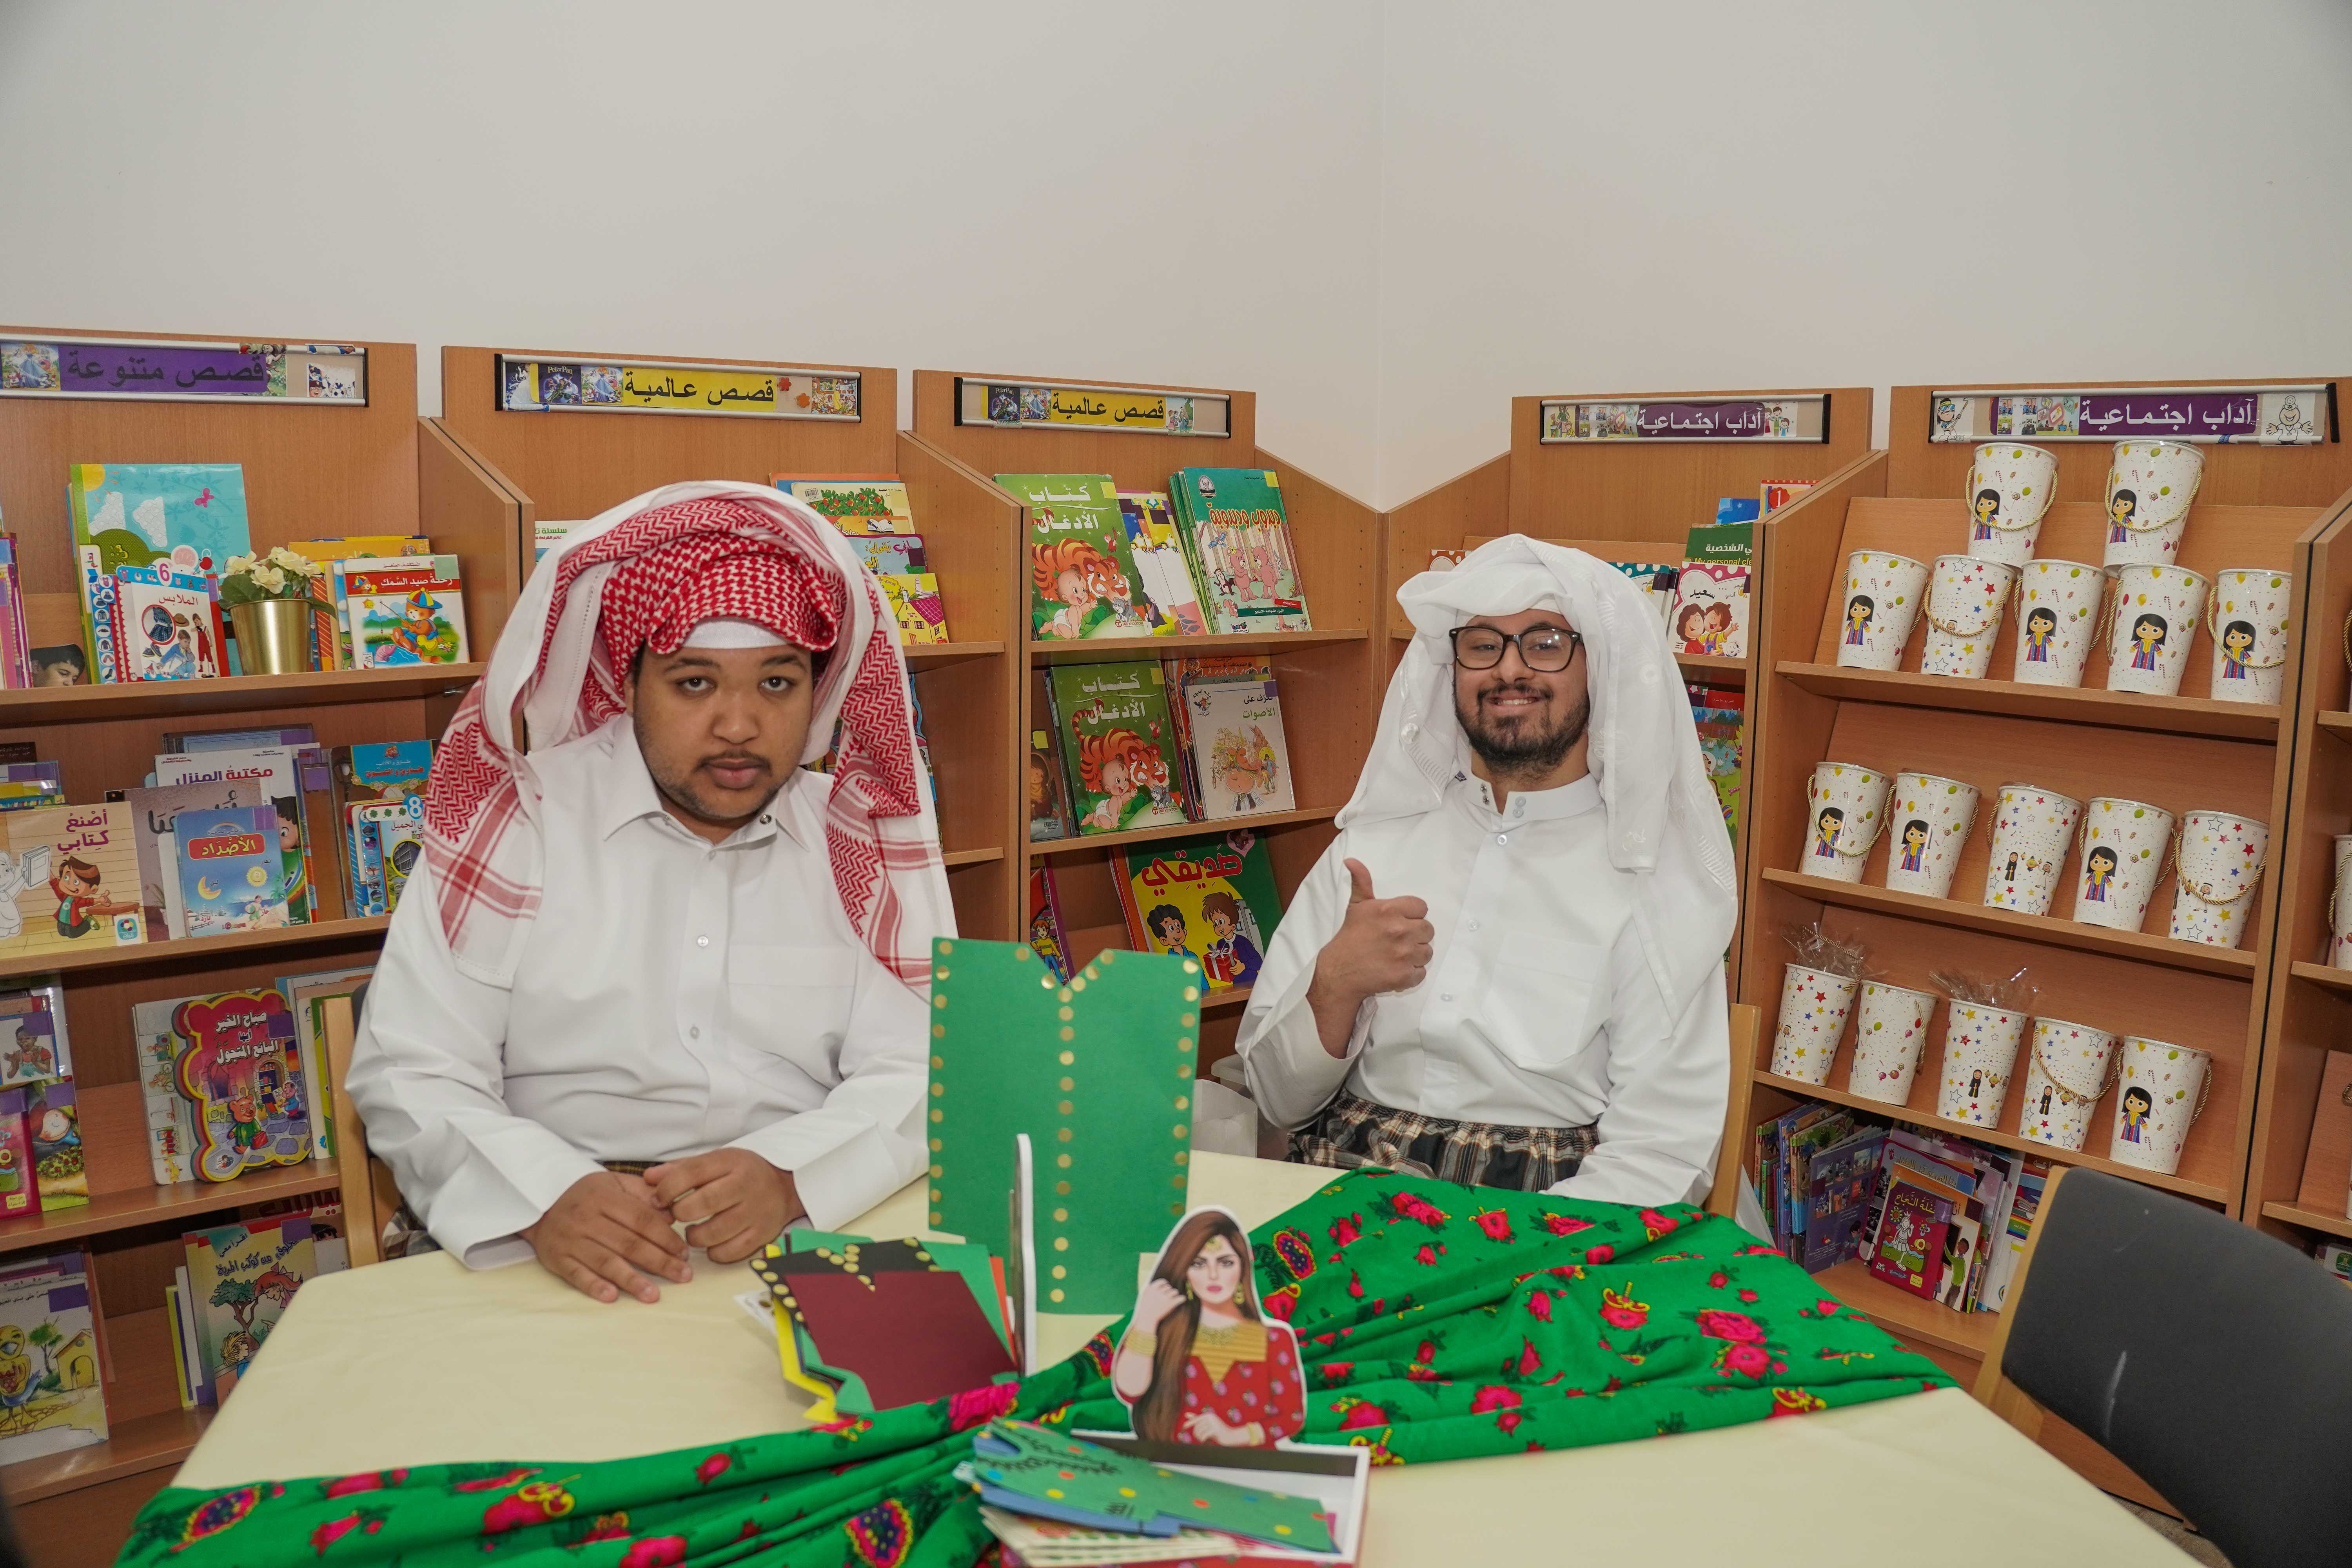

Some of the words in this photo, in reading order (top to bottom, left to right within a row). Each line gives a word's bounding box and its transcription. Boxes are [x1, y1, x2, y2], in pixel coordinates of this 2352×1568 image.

[67, 351, 164, 388] متنوعة
[176, 353, 265, 388] قصص
[562, 366, 573, 375] Pan
[624, 371, 697, 403] عالمية
[707, 379, 774, 405] قصص
[1052, 392, 1106, 420] عالمية
[1114, 400, 1164, 422] قصص
[2079, 400, 2192, 432] اجتماعية
[2203, 399, 2252, 432] آداب
[1637, 411, 1719, 436] اجتماعية
[1726, 408, 1762, 435] آداب
[1029, 486, 1091, 505] كتاب
[1038, 510, 1099, 533] الأدغال
[1706, 543, 1744, 554] الشخصية
[160, 563, 170, 581] 6
[159, 594, 198, 606] الملابس
[1690, 589, 1715, 599] سعيد
[1083, 673, 1140, 696] كتاب
[1244, 695, 1255, 704] على
[1087, 699, 1145, 724] الأدغال
[1243, 707, 1275, 720] الأصوات
[409, 797, 422, 817] 8
